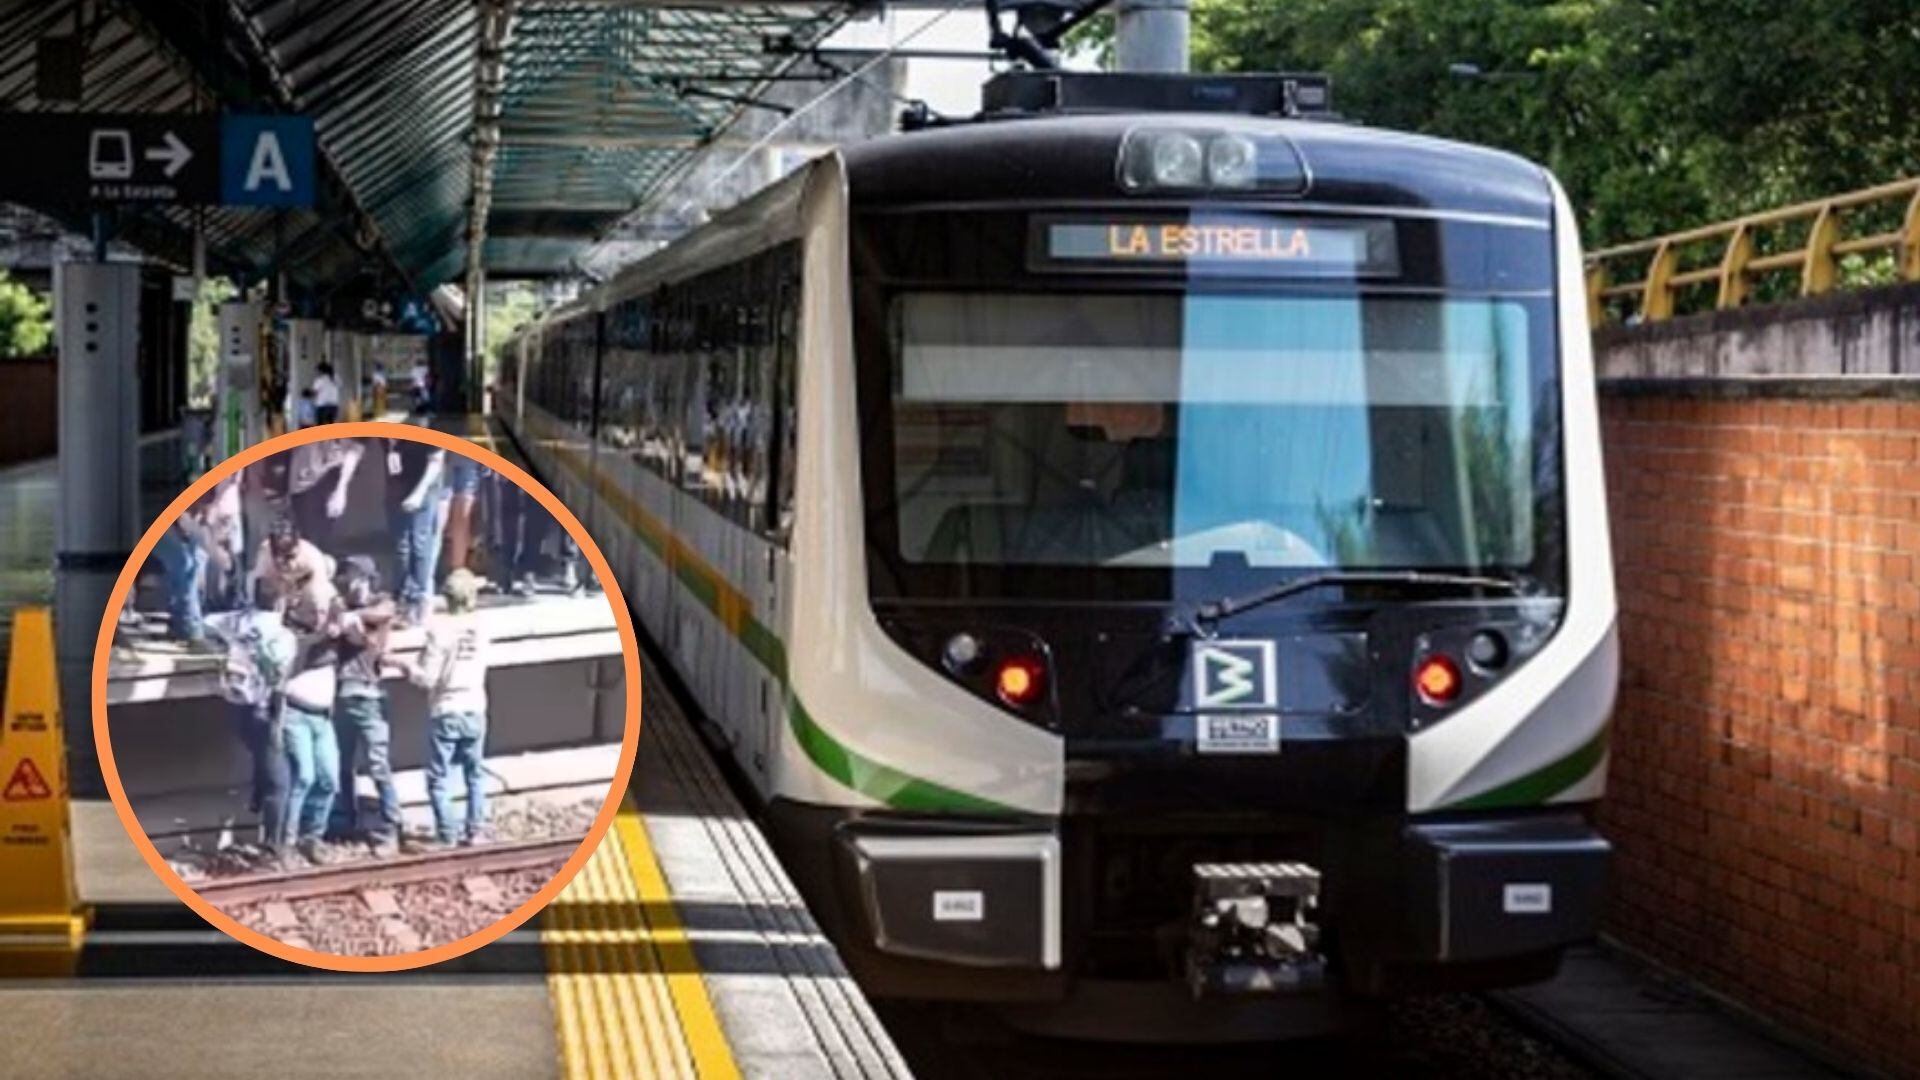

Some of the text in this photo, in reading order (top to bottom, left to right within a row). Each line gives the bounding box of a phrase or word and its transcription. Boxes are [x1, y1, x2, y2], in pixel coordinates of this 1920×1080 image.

[243, 130, 293, 192] A
[1110, 225, 1310, 258] LA ESTRELLA
